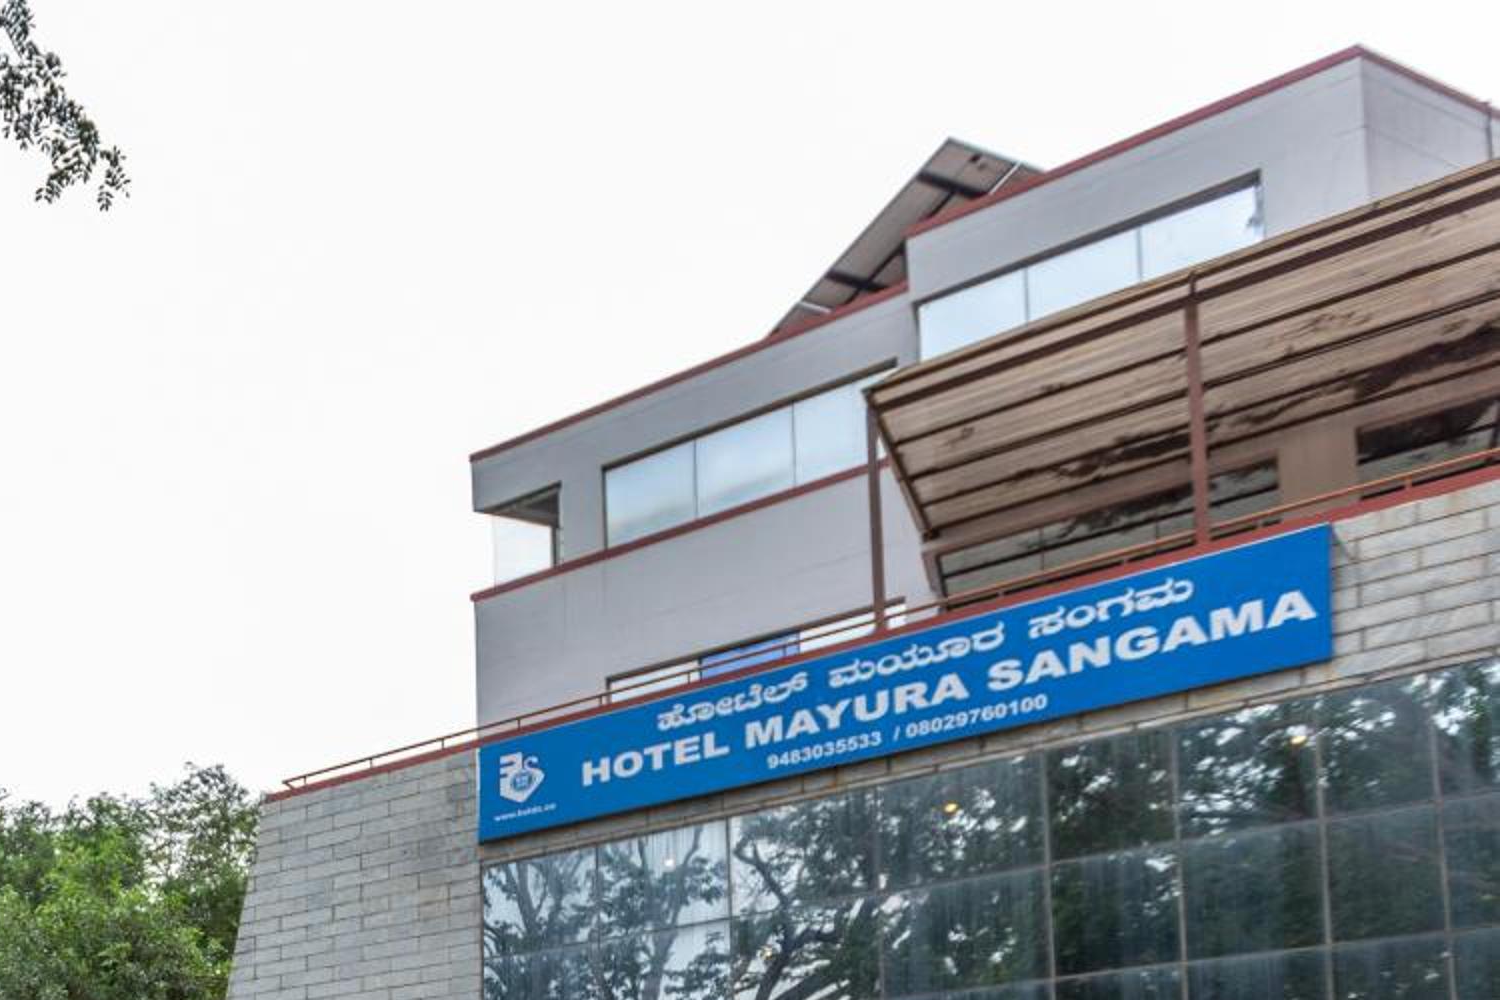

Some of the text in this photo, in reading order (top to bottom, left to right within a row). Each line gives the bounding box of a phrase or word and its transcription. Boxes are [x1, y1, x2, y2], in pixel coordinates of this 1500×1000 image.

[582, 589, 1318, 786] HOTEL MAYURA SANGAMA
[828, 622, 1005, 688] ಮಯೂರ
[1028, 578, 1194, 637] ಸಂಗಮ
[767, 731, 882, 769] 9483035533
